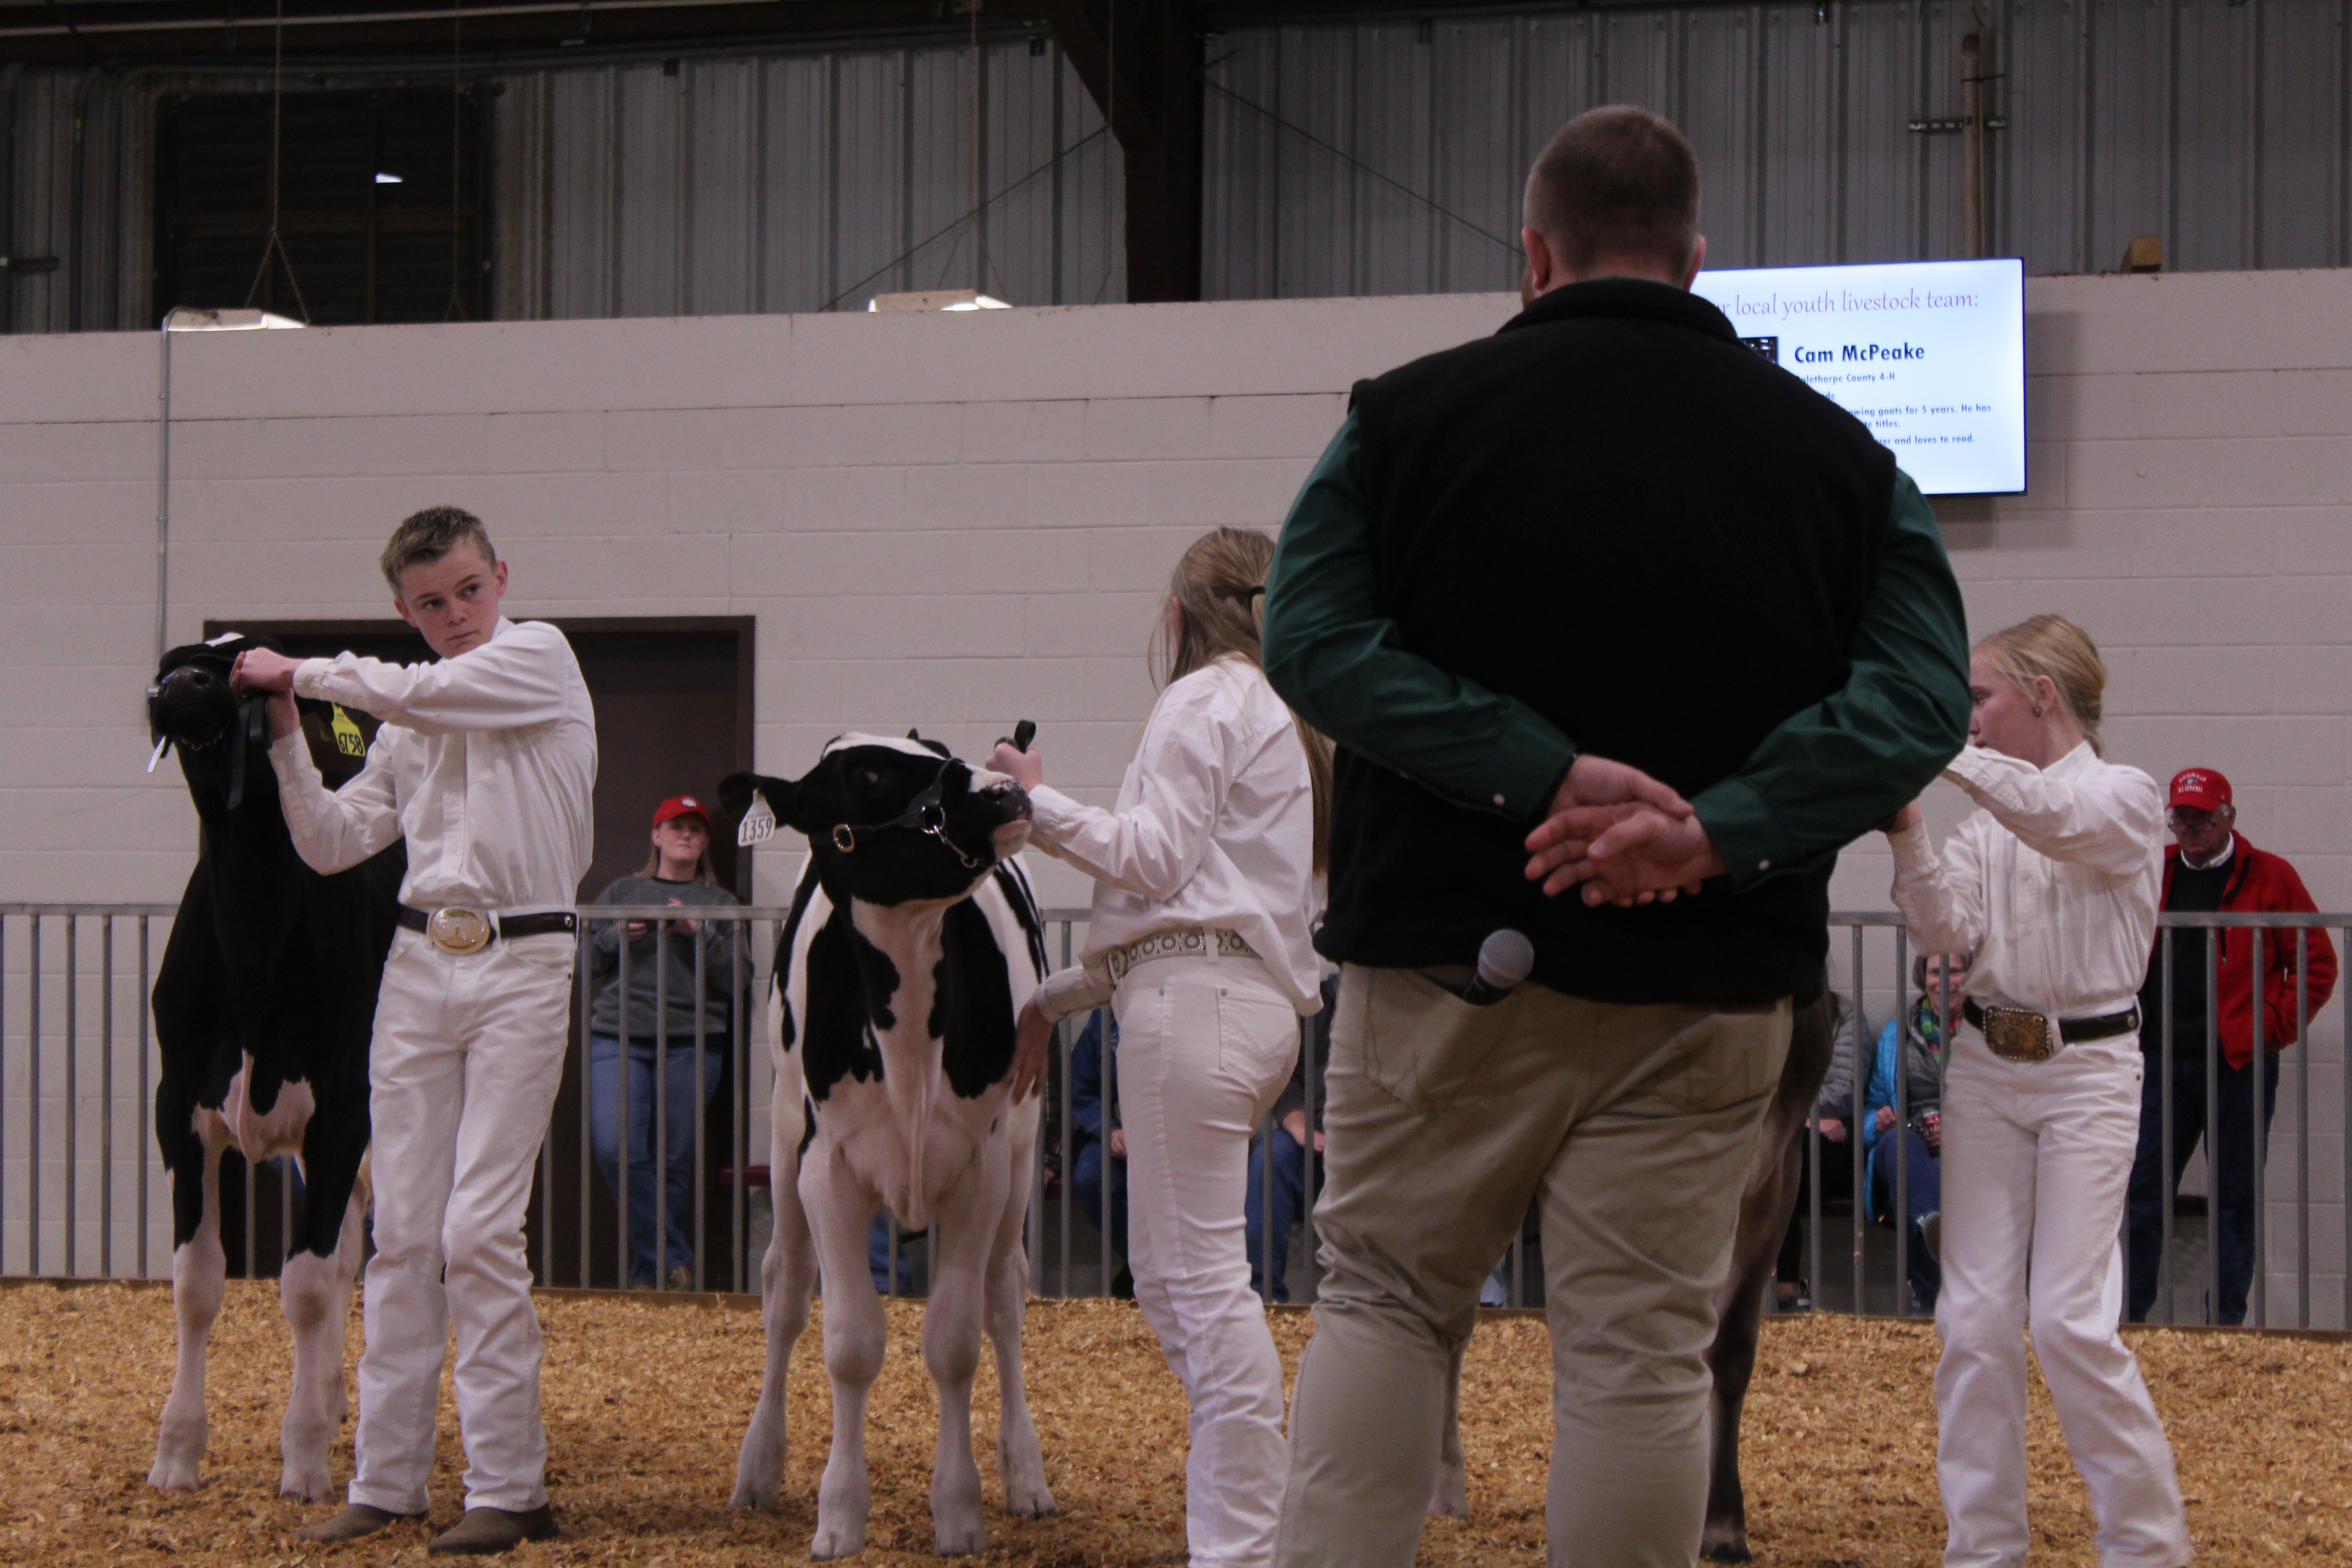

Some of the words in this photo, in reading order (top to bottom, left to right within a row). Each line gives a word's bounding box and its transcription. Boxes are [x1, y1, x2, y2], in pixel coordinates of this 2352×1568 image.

[1736, 293, 1777, 315] local
[1782, 291, 1836, 321] youth
[1842, 288, 1920, 311] livestock
[1926, 290, 1978, 309] team:
[1794, 346, 1833, 363] Cam
[1842, 342, 1925, 362] McPeake
[1846, 373, 1876, 383] County
[1880, 372, 1895, 382] 4-H
[1878, 407, 1903, 417] goats
[1906, 406, 1918, 414] for
[1922, 405, 1927, 414] 5
[1931, 407, 1957, 416] years.
[1961, 403, 1973, 412] He
[1976, 403, 1992, 412] has
[1876, 419, 1901, 428] titles.
[1894, 436, 1911, 444] and
[1915, 435, 1937, 444] loves
[1952, 433, 1975, 443] read.
[742, 818, 773, 842] 1359
